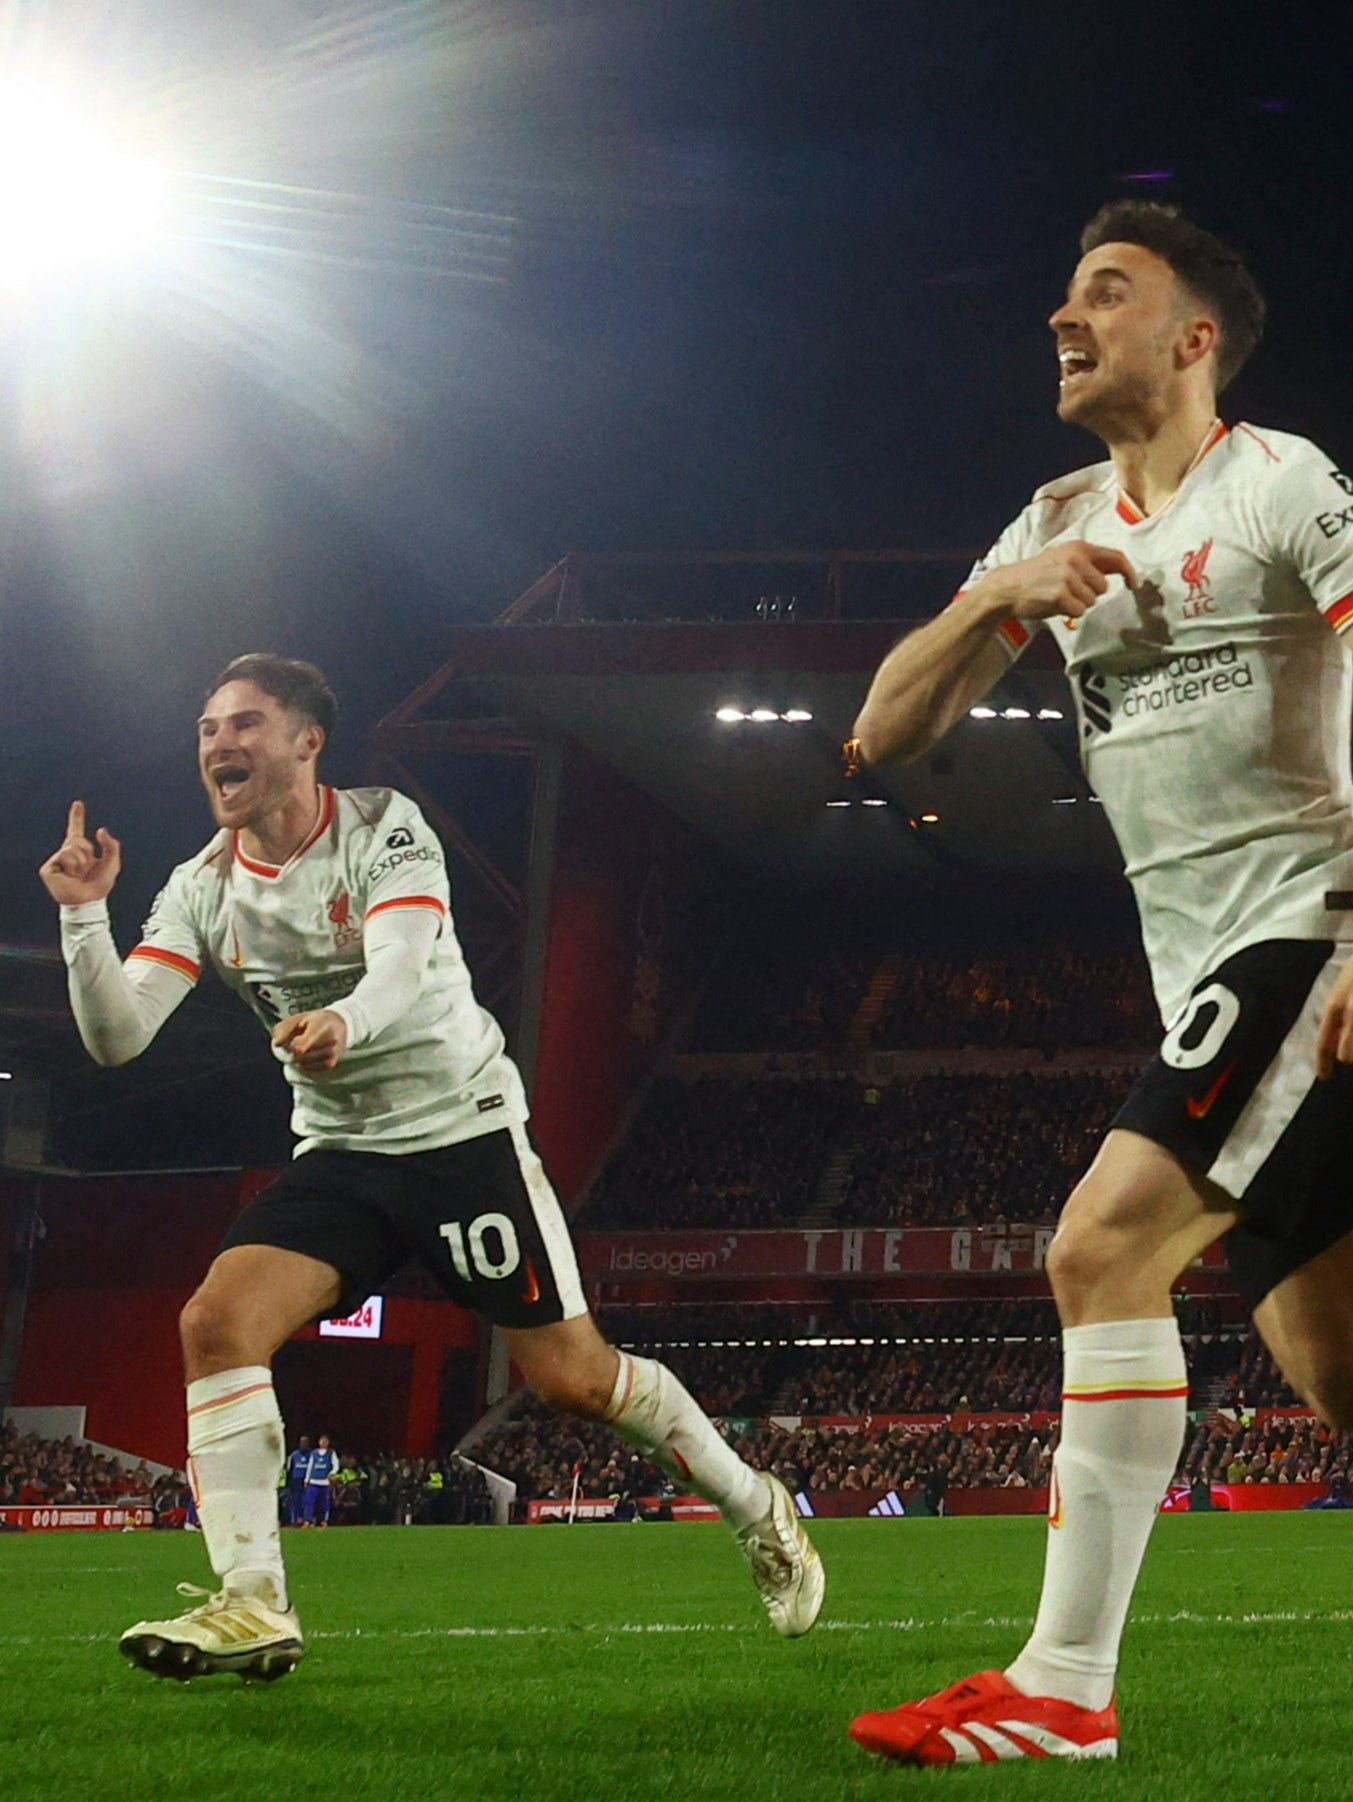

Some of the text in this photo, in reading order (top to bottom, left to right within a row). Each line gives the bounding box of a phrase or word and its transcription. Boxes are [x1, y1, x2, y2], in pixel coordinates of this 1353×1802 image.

[1182, 597, 1221, 619] LFC
[1122, 661, 1253, 717] chartered
[1160, 982, 1241, 1070] 0
[439, 1212, 521, 1282] 10
[610, 1247, 717, 1275] Ideagen
[804, 1230, 903, 1272] THE
